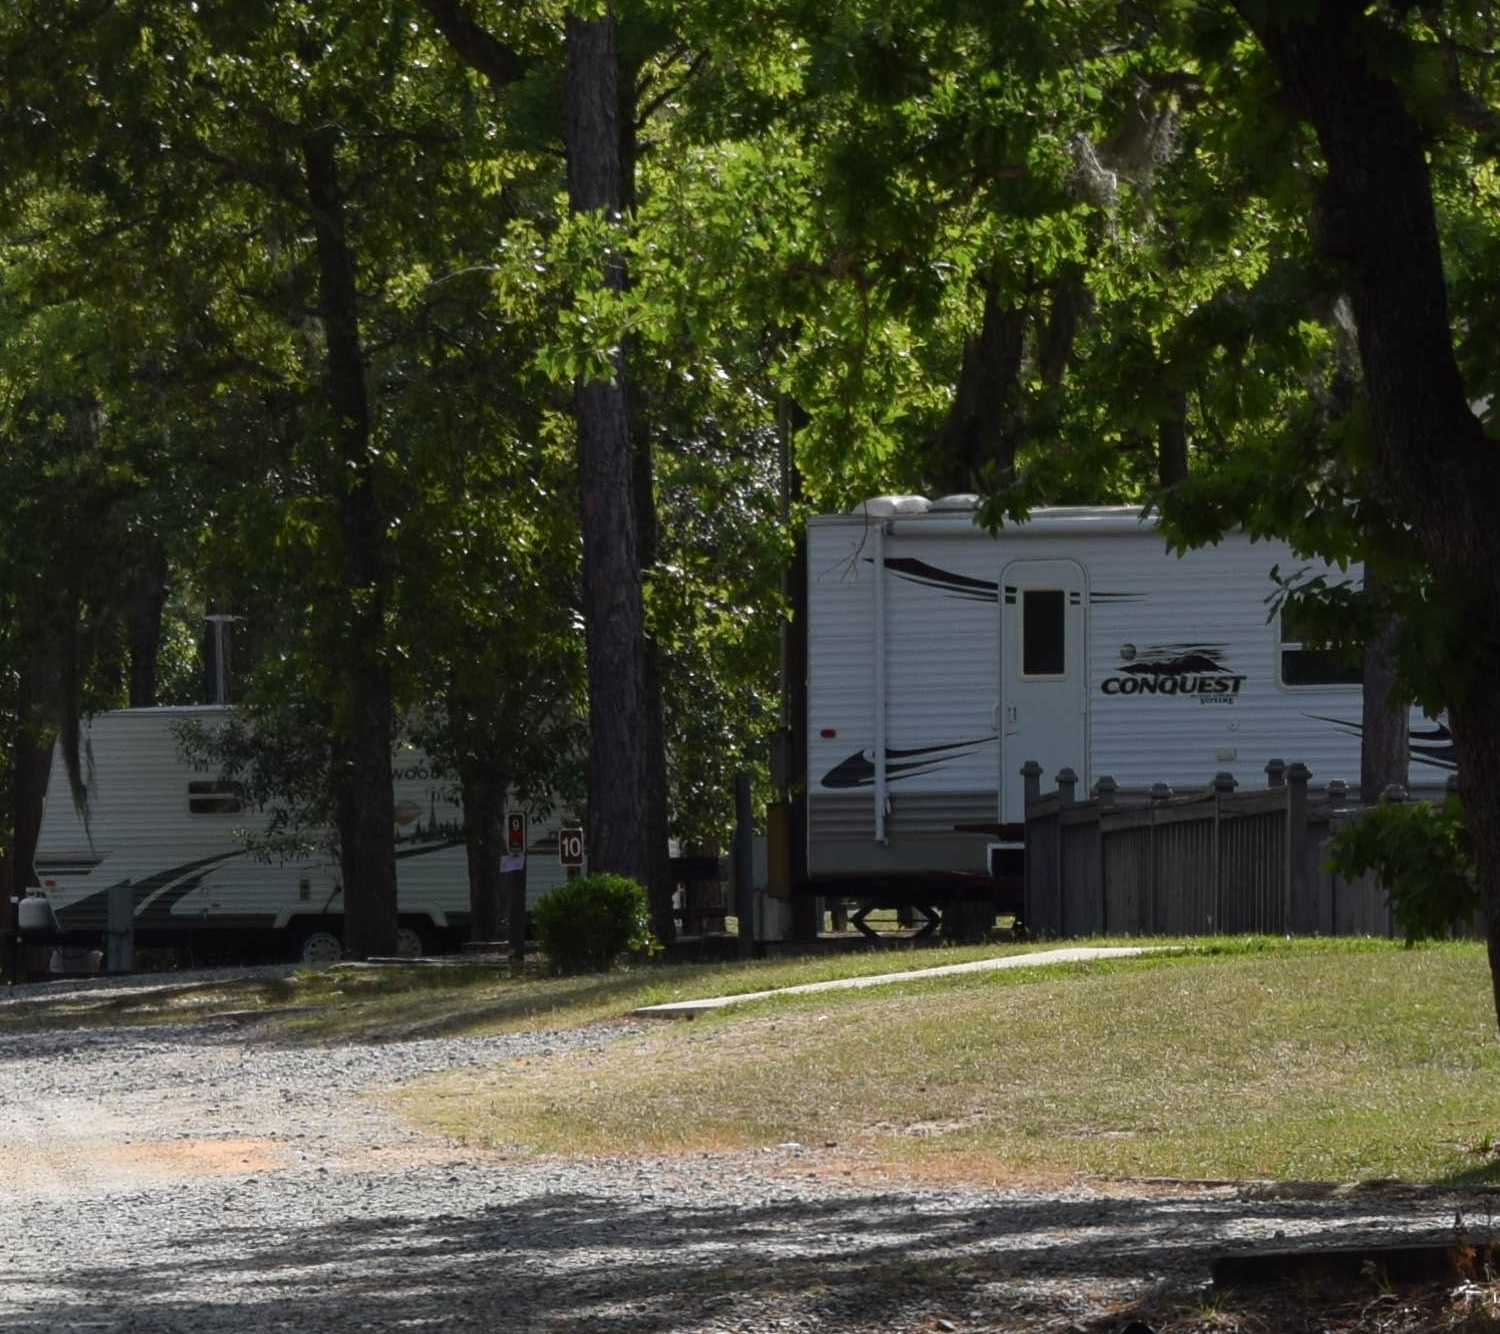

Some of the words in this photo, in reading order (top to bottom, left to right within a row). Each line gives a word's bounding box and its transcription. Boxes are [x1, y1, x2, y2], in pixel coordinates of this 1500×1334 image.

[1101, 675, 1247, 695] CONQUEST
[512, 818, 520, 832] 9
[562, 837, 581, 857] 10
